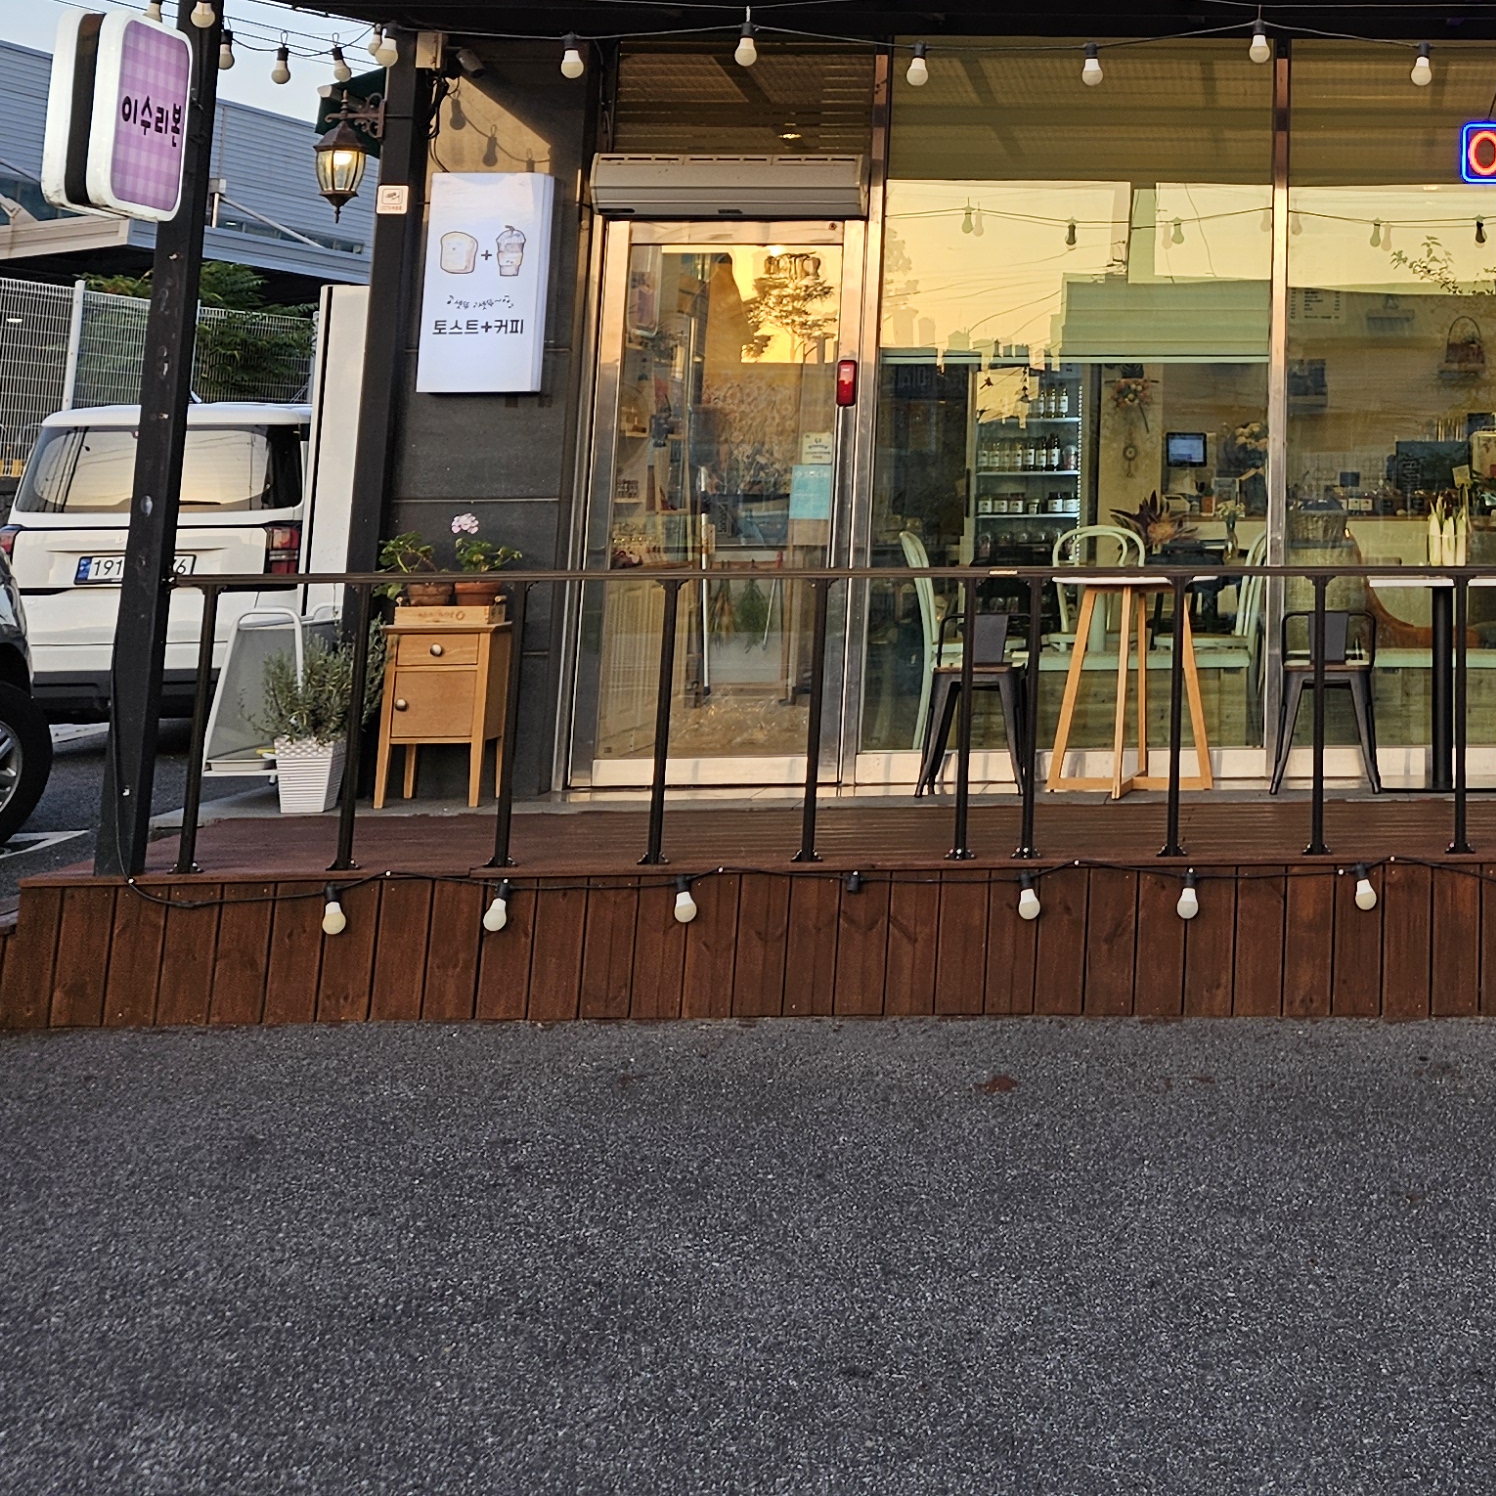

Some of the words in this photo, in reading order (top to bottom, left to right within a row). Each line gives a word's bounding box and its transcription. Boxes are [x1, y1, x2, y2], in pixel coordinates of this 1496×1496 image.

[122, 96, 182, 148] 이수리본
[432, 319, 524, 335] 토스트+커피
[94, 559, 123, 576] 191
